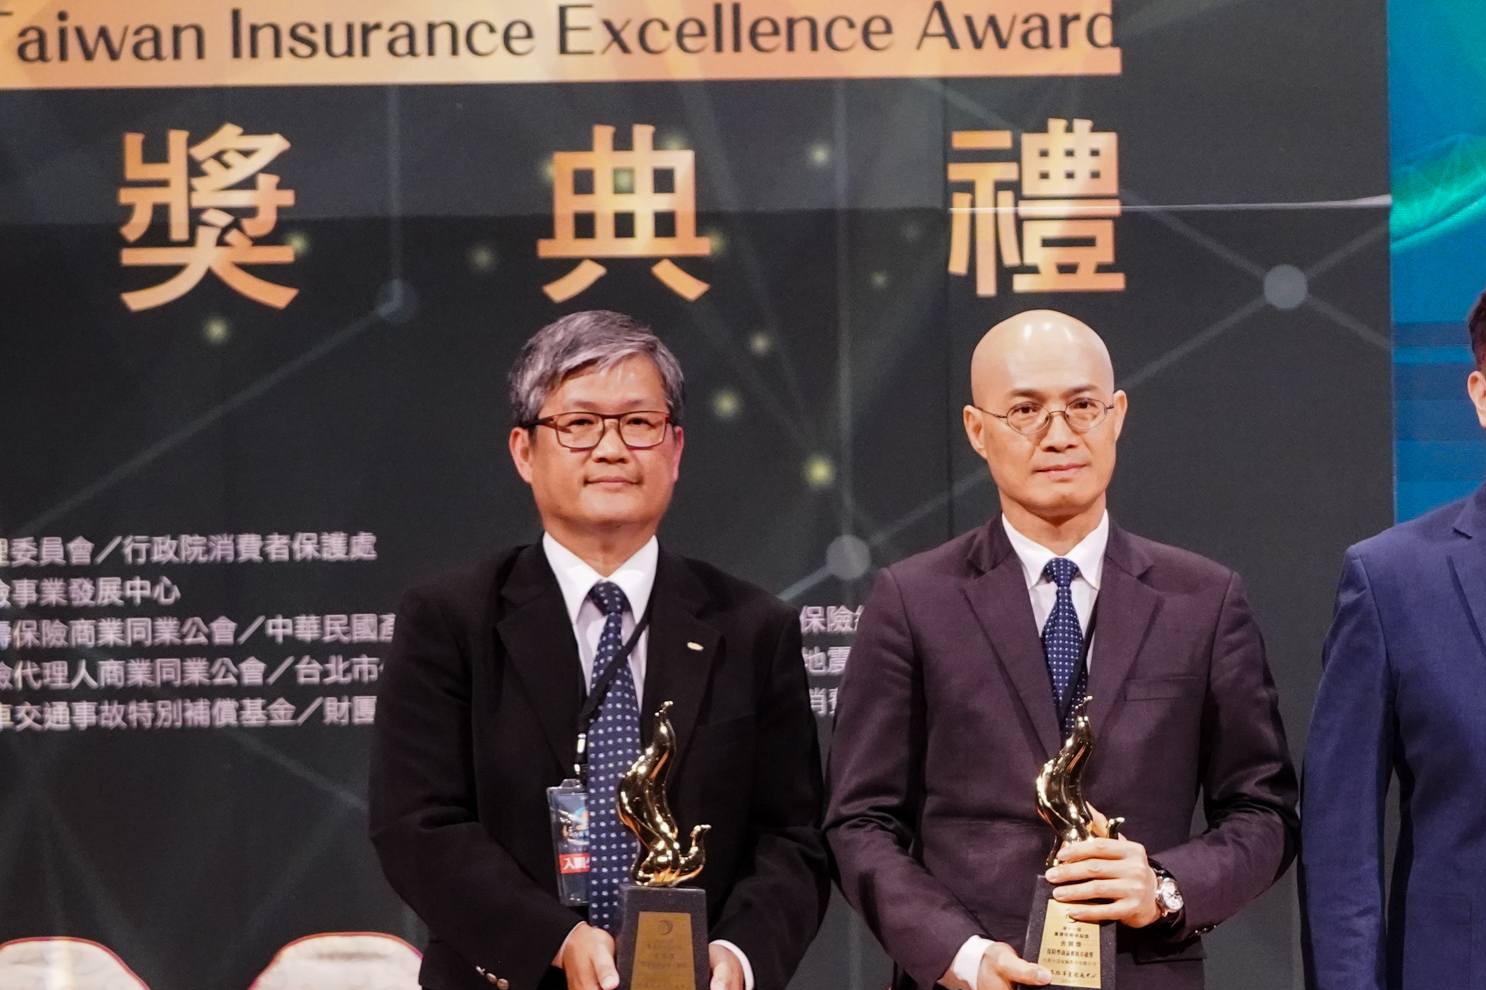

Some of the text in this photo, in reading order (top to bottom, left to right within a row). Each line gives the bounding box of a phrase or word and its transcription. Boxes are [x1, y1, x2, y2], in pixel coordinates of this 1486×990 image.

[0, 0, 1120, 63] aiwan Insurance Excellence Award
[0, 654, 386, 690] 代理人商業同業公會／台北市
